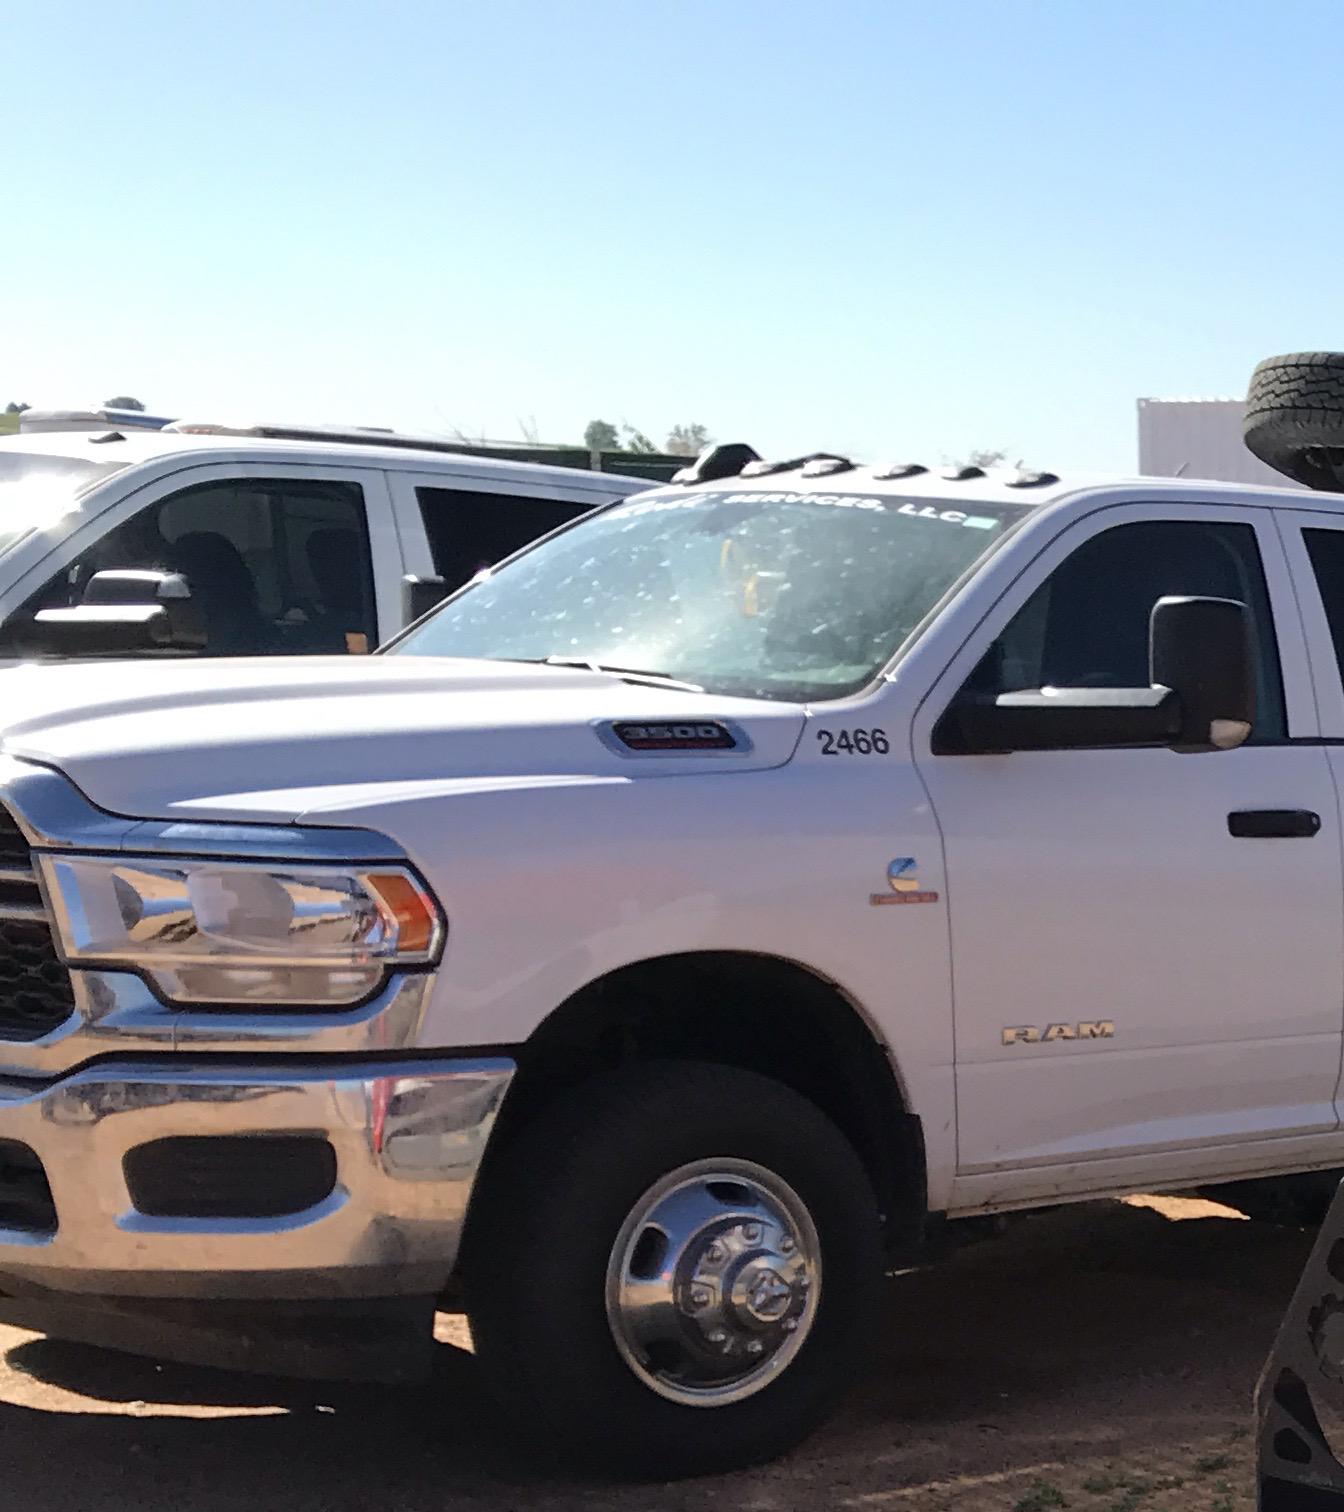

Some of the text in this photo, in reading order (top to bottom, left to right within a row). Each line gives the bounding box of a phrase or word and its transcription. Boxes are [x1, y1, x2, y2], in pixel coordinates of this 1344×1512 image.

[897, 503, 968, 524] LLC
[816, 728, 890, 755] 2466
[1001, 1019, 1116, 1046] RAM
